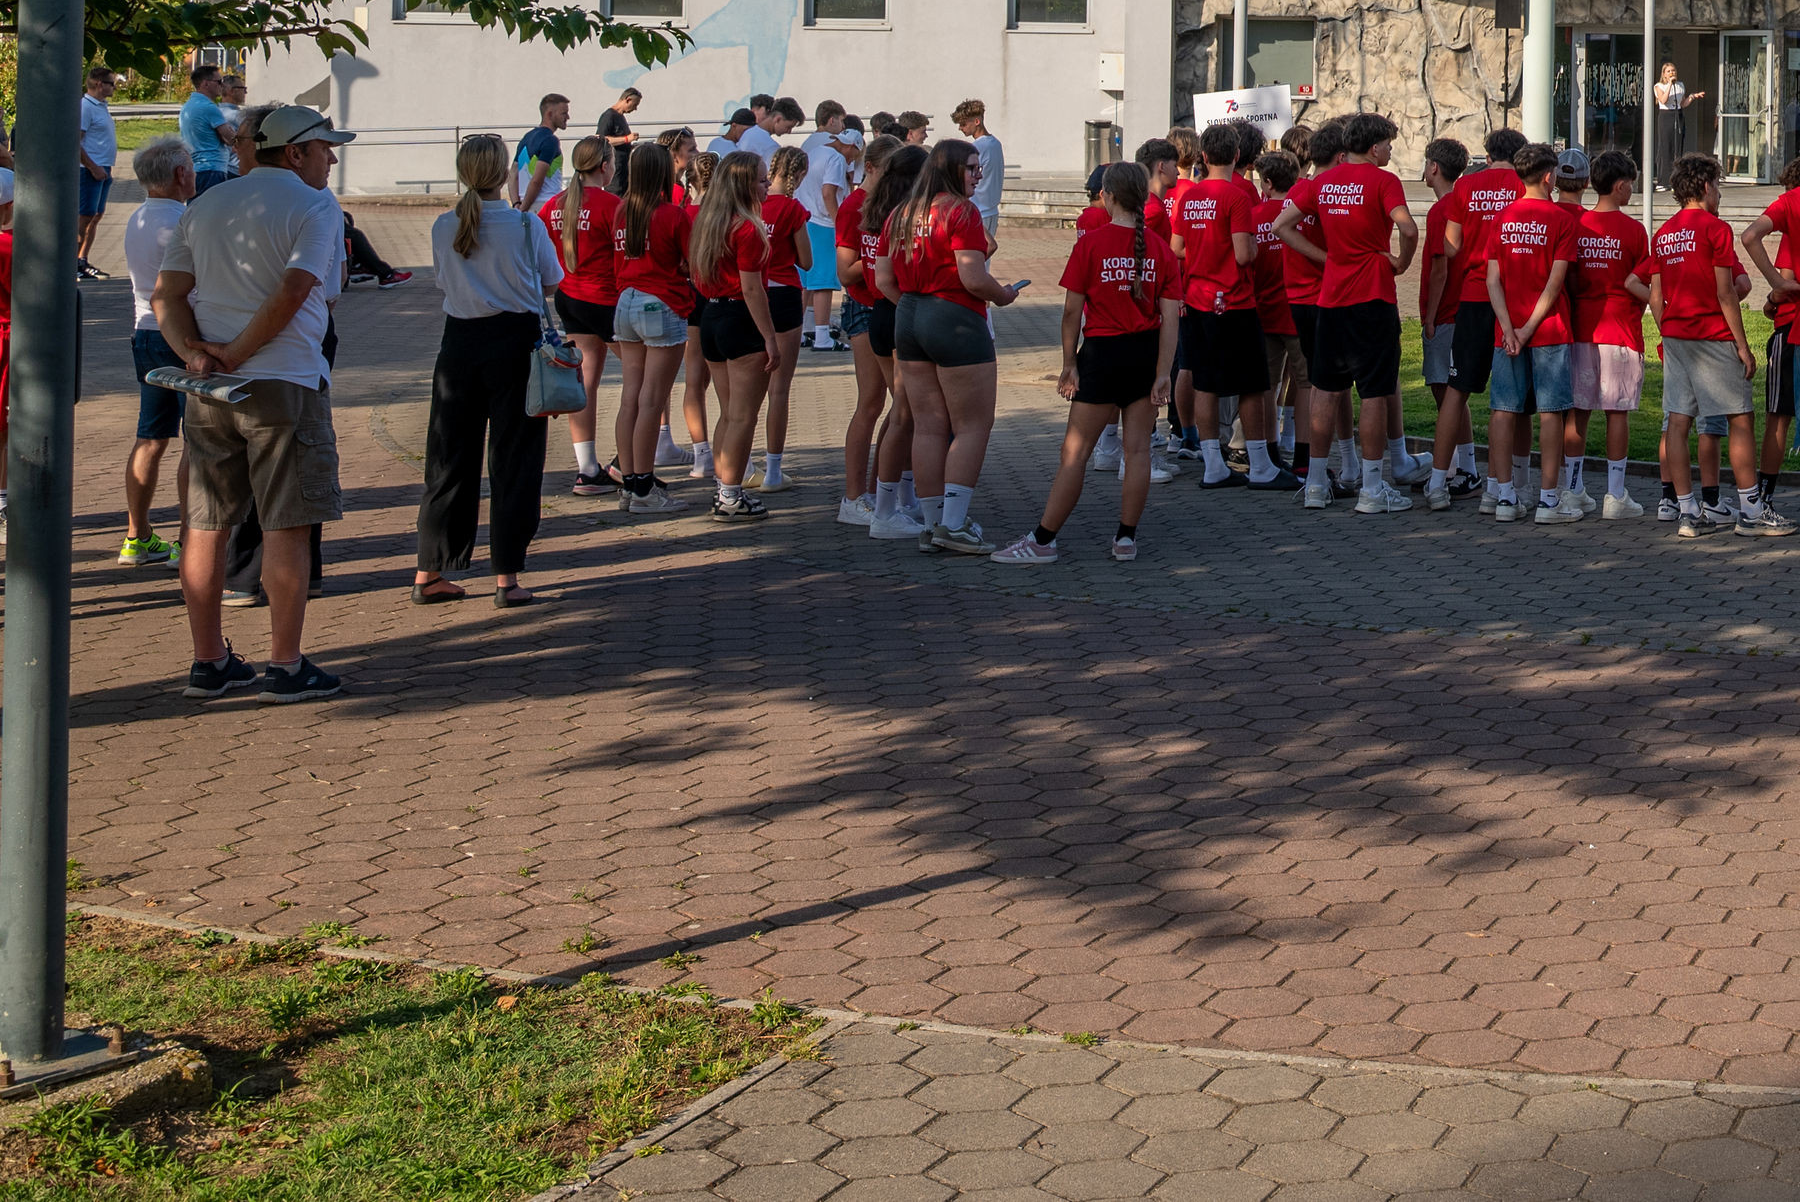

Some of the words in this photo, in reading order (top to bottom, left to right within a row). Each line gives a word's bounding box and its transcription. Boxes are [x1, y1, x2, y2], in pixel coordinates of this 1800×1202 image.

[1246, 113, 1278, 123] ŠPORTNA
[1321, 182, 1364, 194] KOROŠKI
[1318, 194, 1364, 205] SLOVENCI
[1471, 188, 1516, 201] KOROŠKI
[1185, 198, 1216, 210] KOROŠKI
[1502, 221, 1547, 234] KOROŠKI
[1500, 233, 1548, 245] SLOVENCI
[1102, 257, 1154, 270] KOROKI
